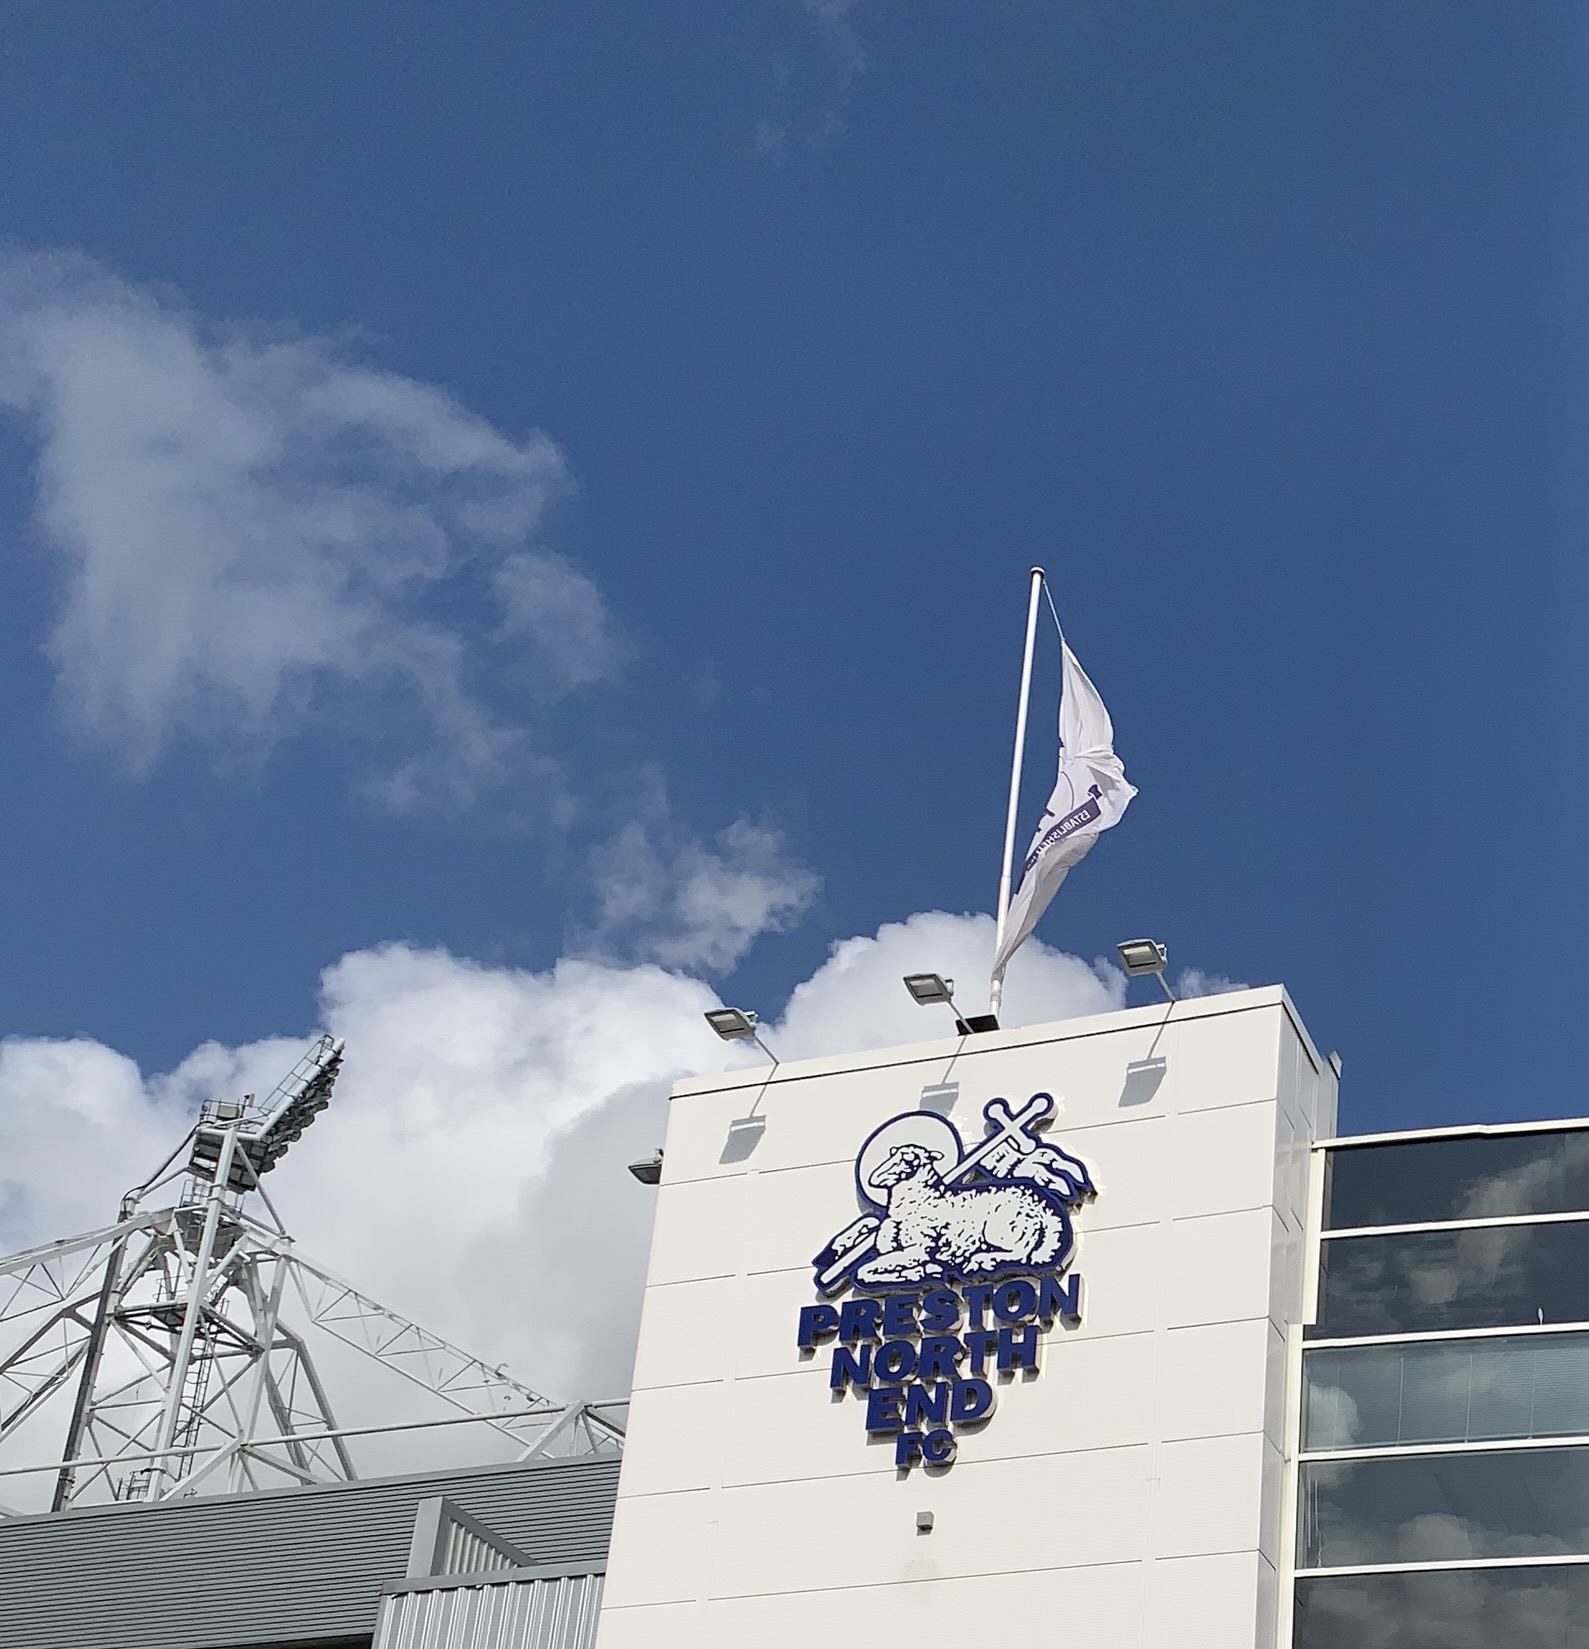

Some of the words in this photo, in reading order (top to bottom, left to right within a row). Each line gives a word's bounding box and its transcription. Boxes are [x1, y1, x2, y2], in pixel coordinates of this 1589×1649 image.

[797, 1274, 1081, 1347] PRESTON
[830, 1325, 1040, 1390] NORTH
[865, 1378, 994, 1432] END
[895, 1428, 956, 1466] FC
